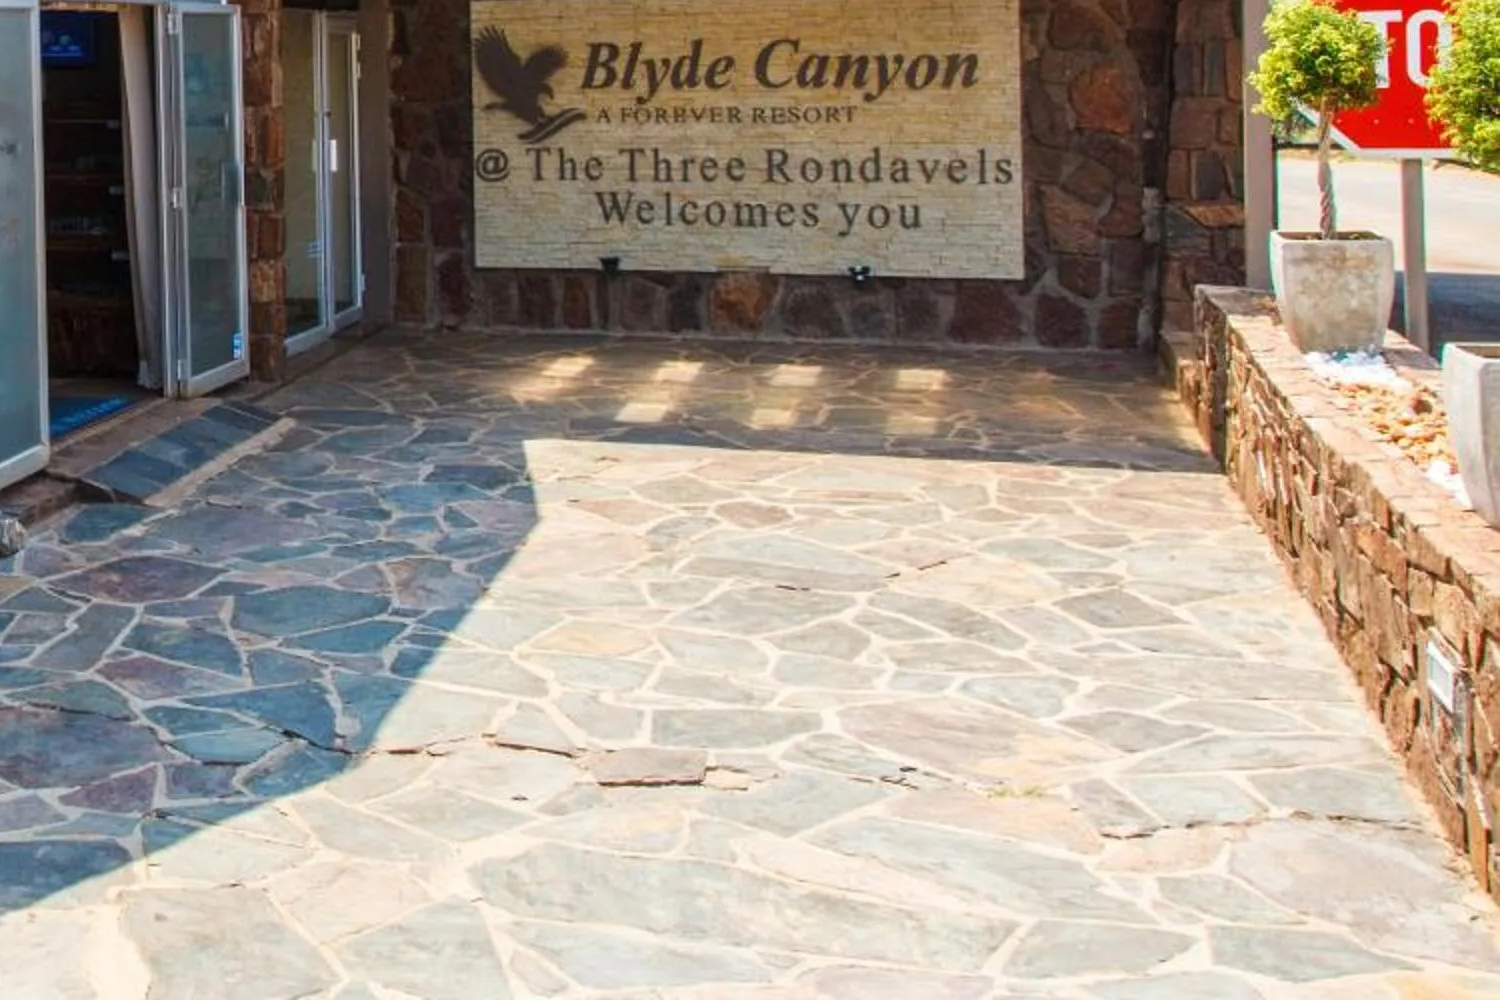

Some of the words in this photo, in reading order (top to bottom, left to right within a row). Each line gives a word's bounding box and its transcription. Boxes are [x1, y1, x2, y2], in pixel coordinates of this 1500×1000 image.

[580, 38, 735, 105] Blyde
[754, 38, 979, 102] Canyon
[596, 107, 611, 124] A
[620, 106, 743, 125] FOREVER
[751, 105, 858, 124] RESORT
[475, 148, 510, 183] @
[525, 147, 603, 182] The
[618, 147, 747, 183] Three
[764, 147, 1013, 185] Rondavels
[595, 190, 820, 228] Welcomes
[837, 202, 922, 237] you
